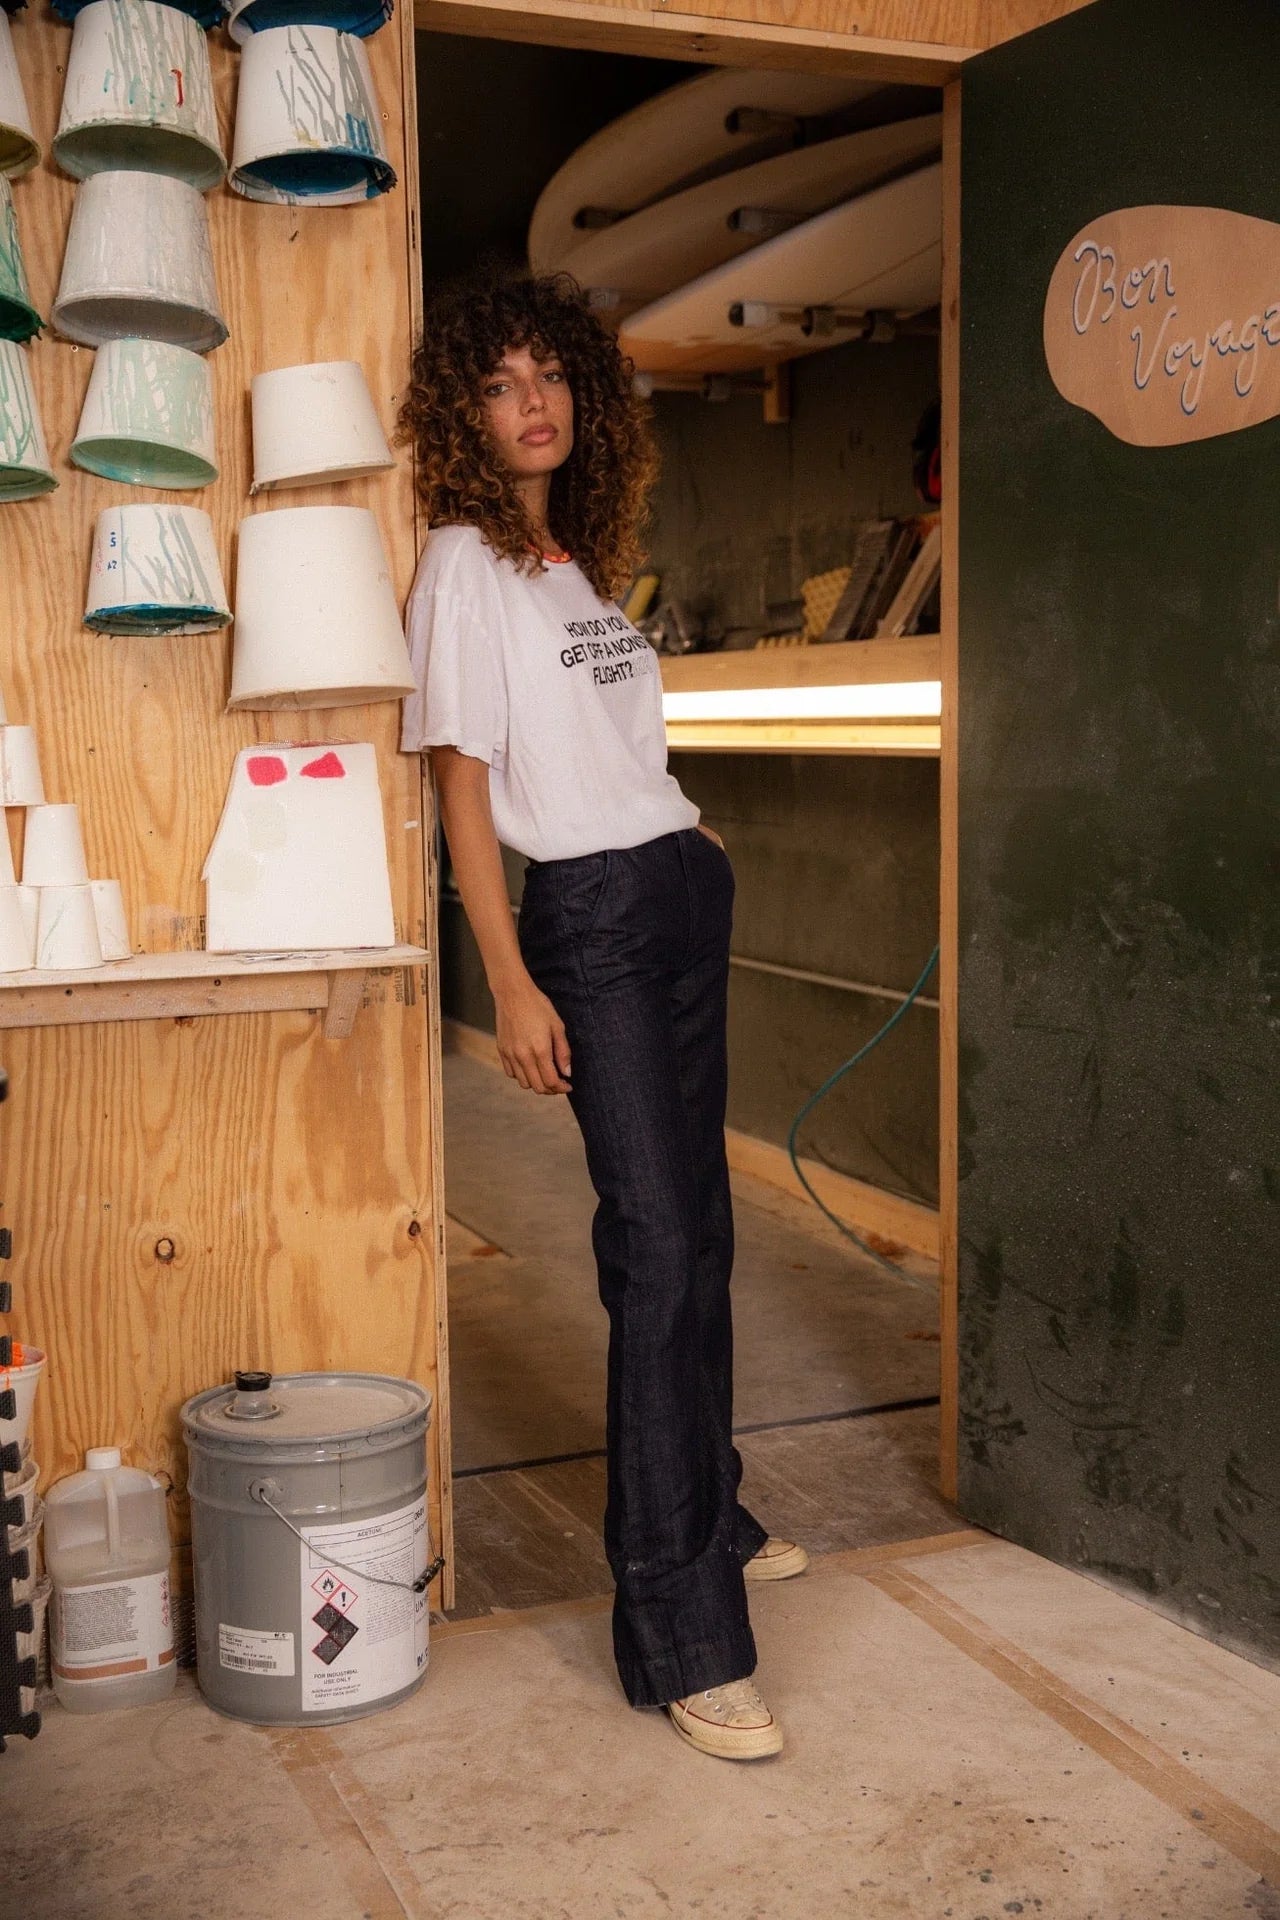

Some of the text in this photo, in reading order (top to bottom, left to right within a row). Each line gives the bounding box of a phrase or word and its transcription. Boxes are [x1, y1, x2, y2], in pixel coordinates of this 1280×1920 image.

[1072, 240, 1176, 335] Bon
[563, 616, 629, 638] HOW DO YOU
[560, 643, 588, 668] GET
[587, 642, 604, 660] OFF
[603, 642, 616, 659] A
[592, 660, 634, 685] FLIGHT?
[326, 1669, 358, 1678] INDUSTRIAL
